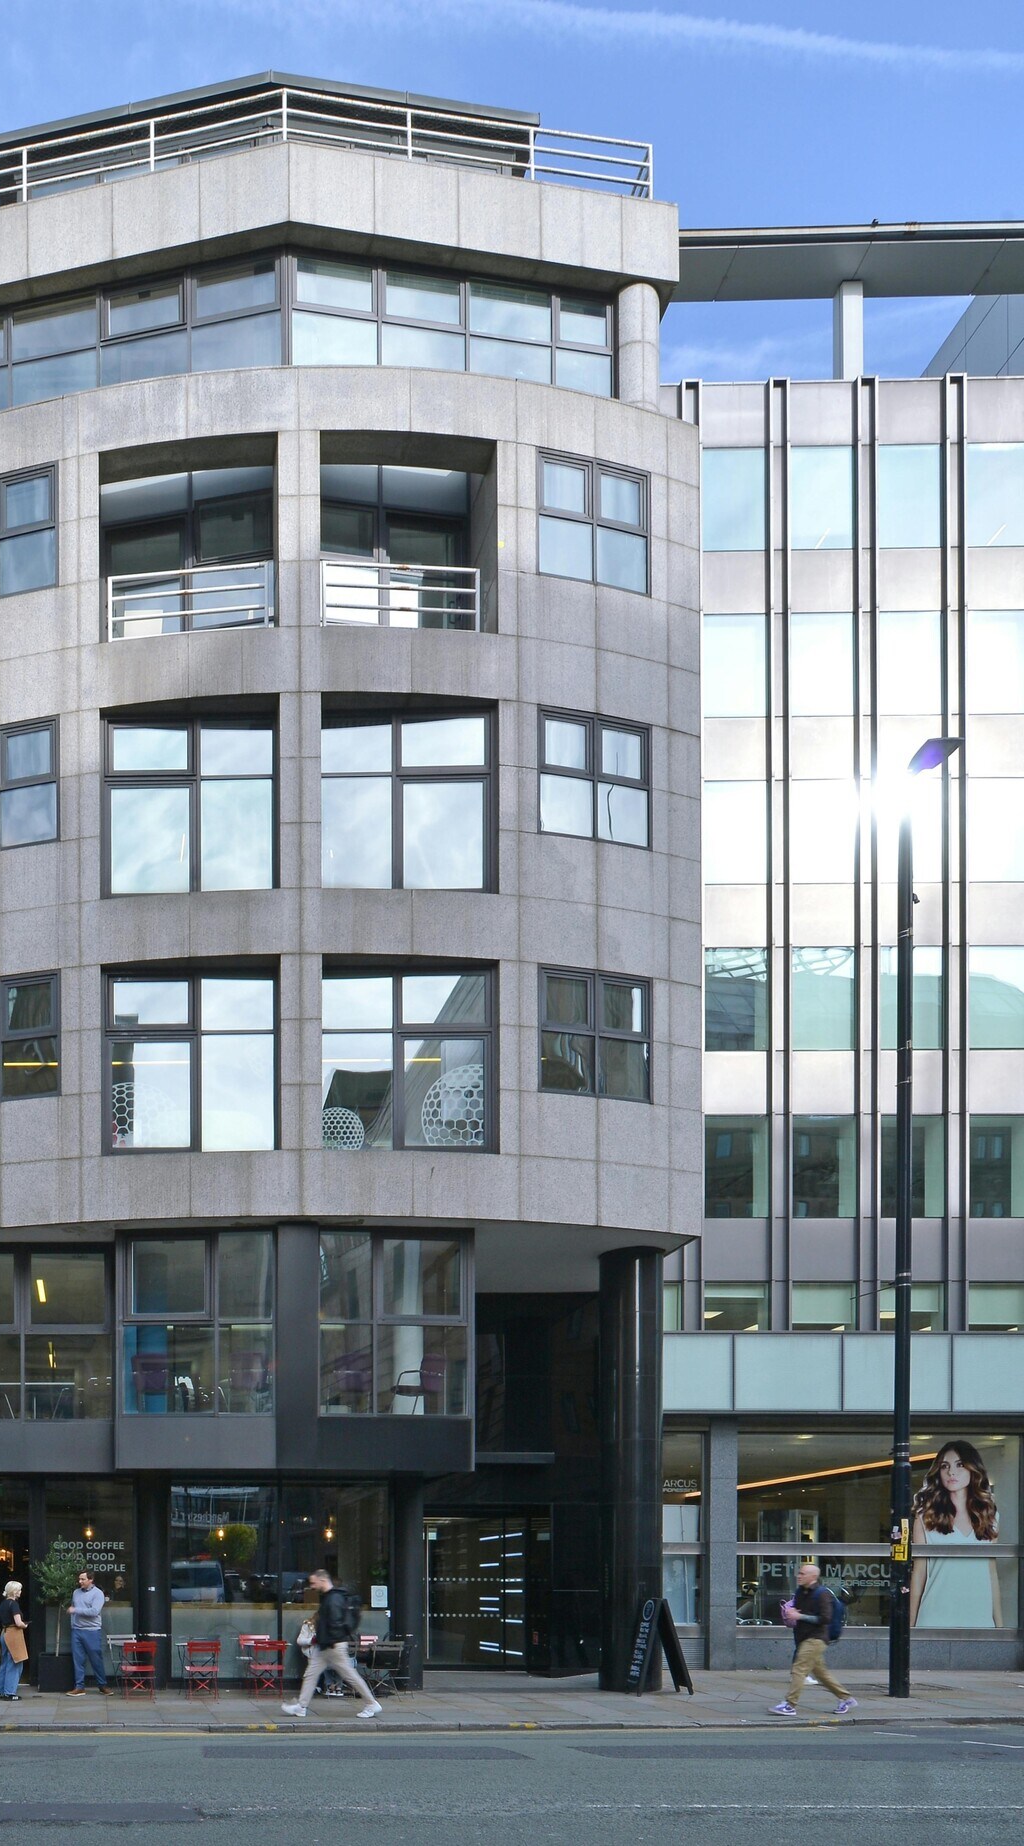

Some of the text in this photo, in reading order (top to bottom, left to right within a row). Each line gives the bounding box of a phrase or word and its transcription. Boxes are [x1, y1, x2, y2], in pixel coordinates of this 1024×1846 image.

[663, 1479, 698, 1488] ARCUS
[53, 1541, 125, 1550] GOOD COFFEE
[86, 1552, 115, 1561] FOOD
[86, 1563, 126, 1572] PEOPLE
[759, 1562, 891, 1579] PET MARCU
[821, 1579, 891, 1587] HAIRDRESSIN
